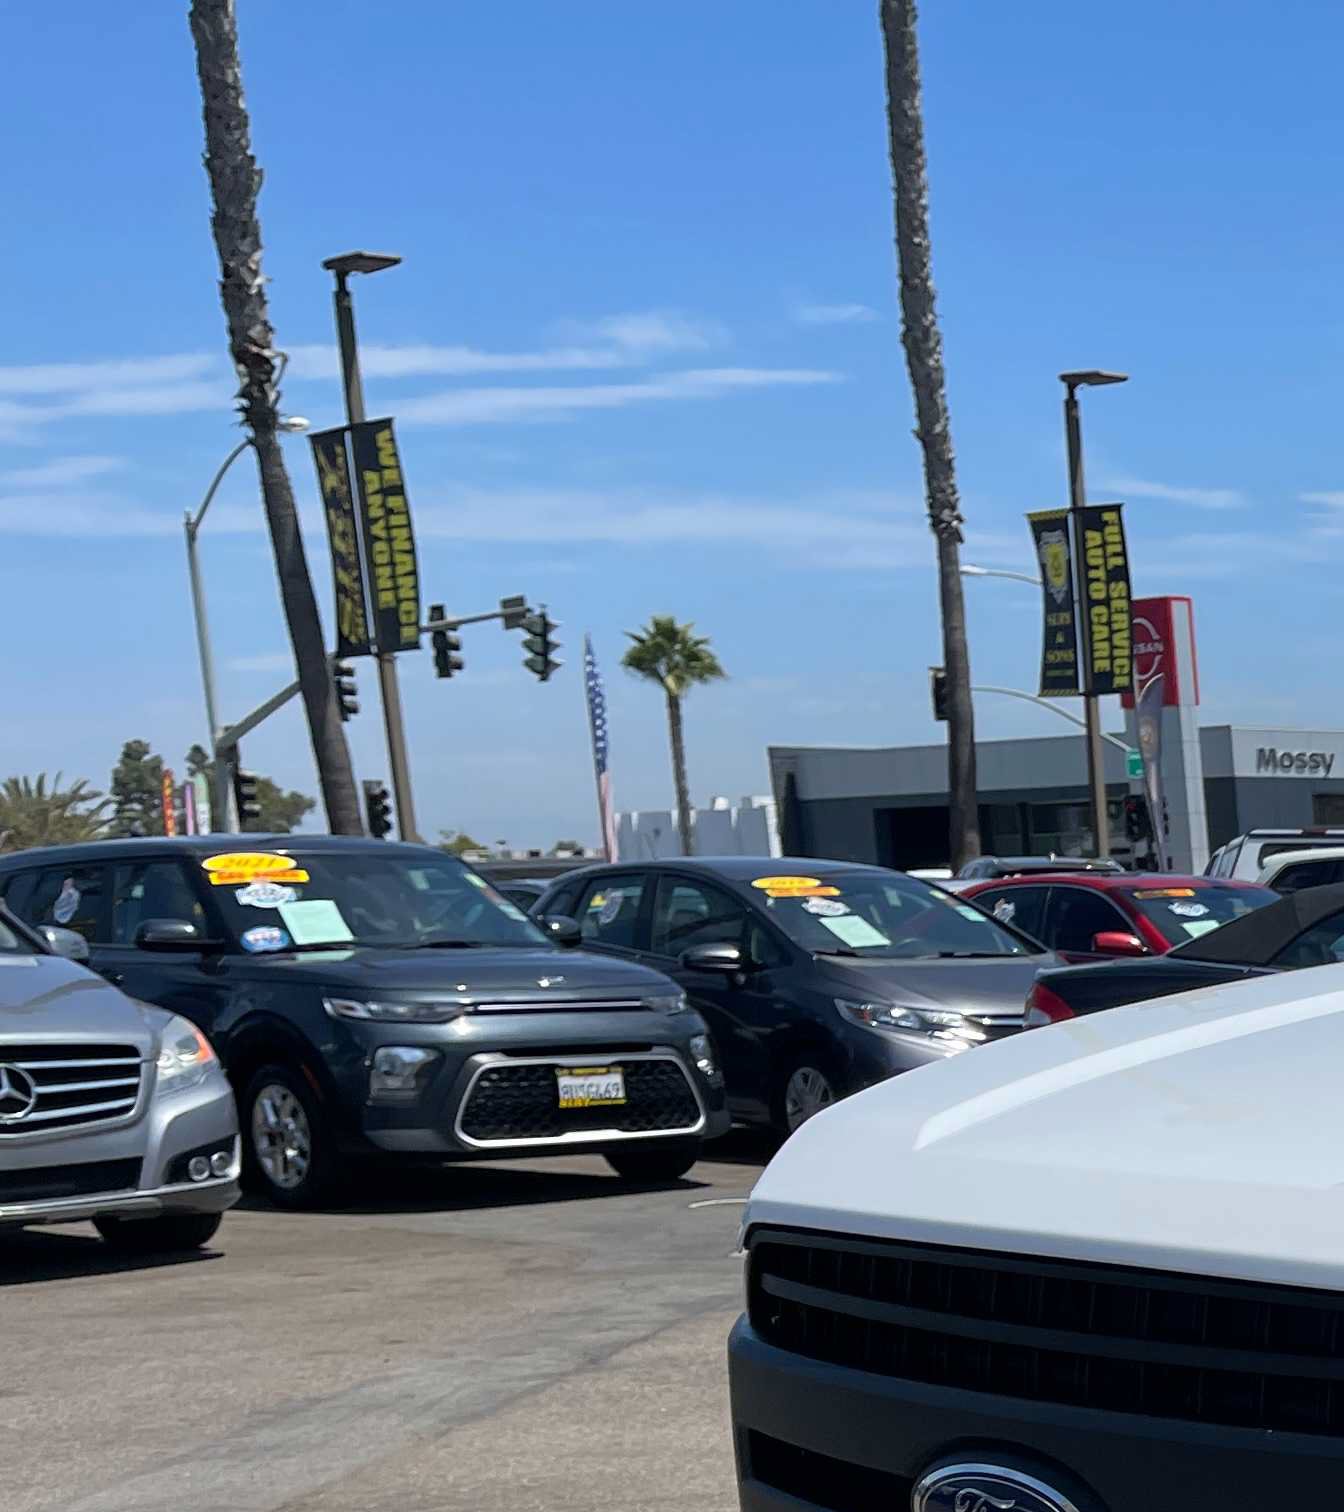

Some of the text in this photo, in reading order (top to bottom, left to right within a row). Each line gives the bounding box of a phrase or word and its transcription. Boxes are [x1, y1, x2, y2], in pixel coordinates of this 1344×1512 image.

[363, 470, 396, 609] ANYONE
[386, 495, 418, 643] FINANCE
[1085, 529, 1111, 673] AUTO CARE
[1101, 511, 1130, 689] FULL SERVICE
[1256, 747, 1335, 777] Mossy
